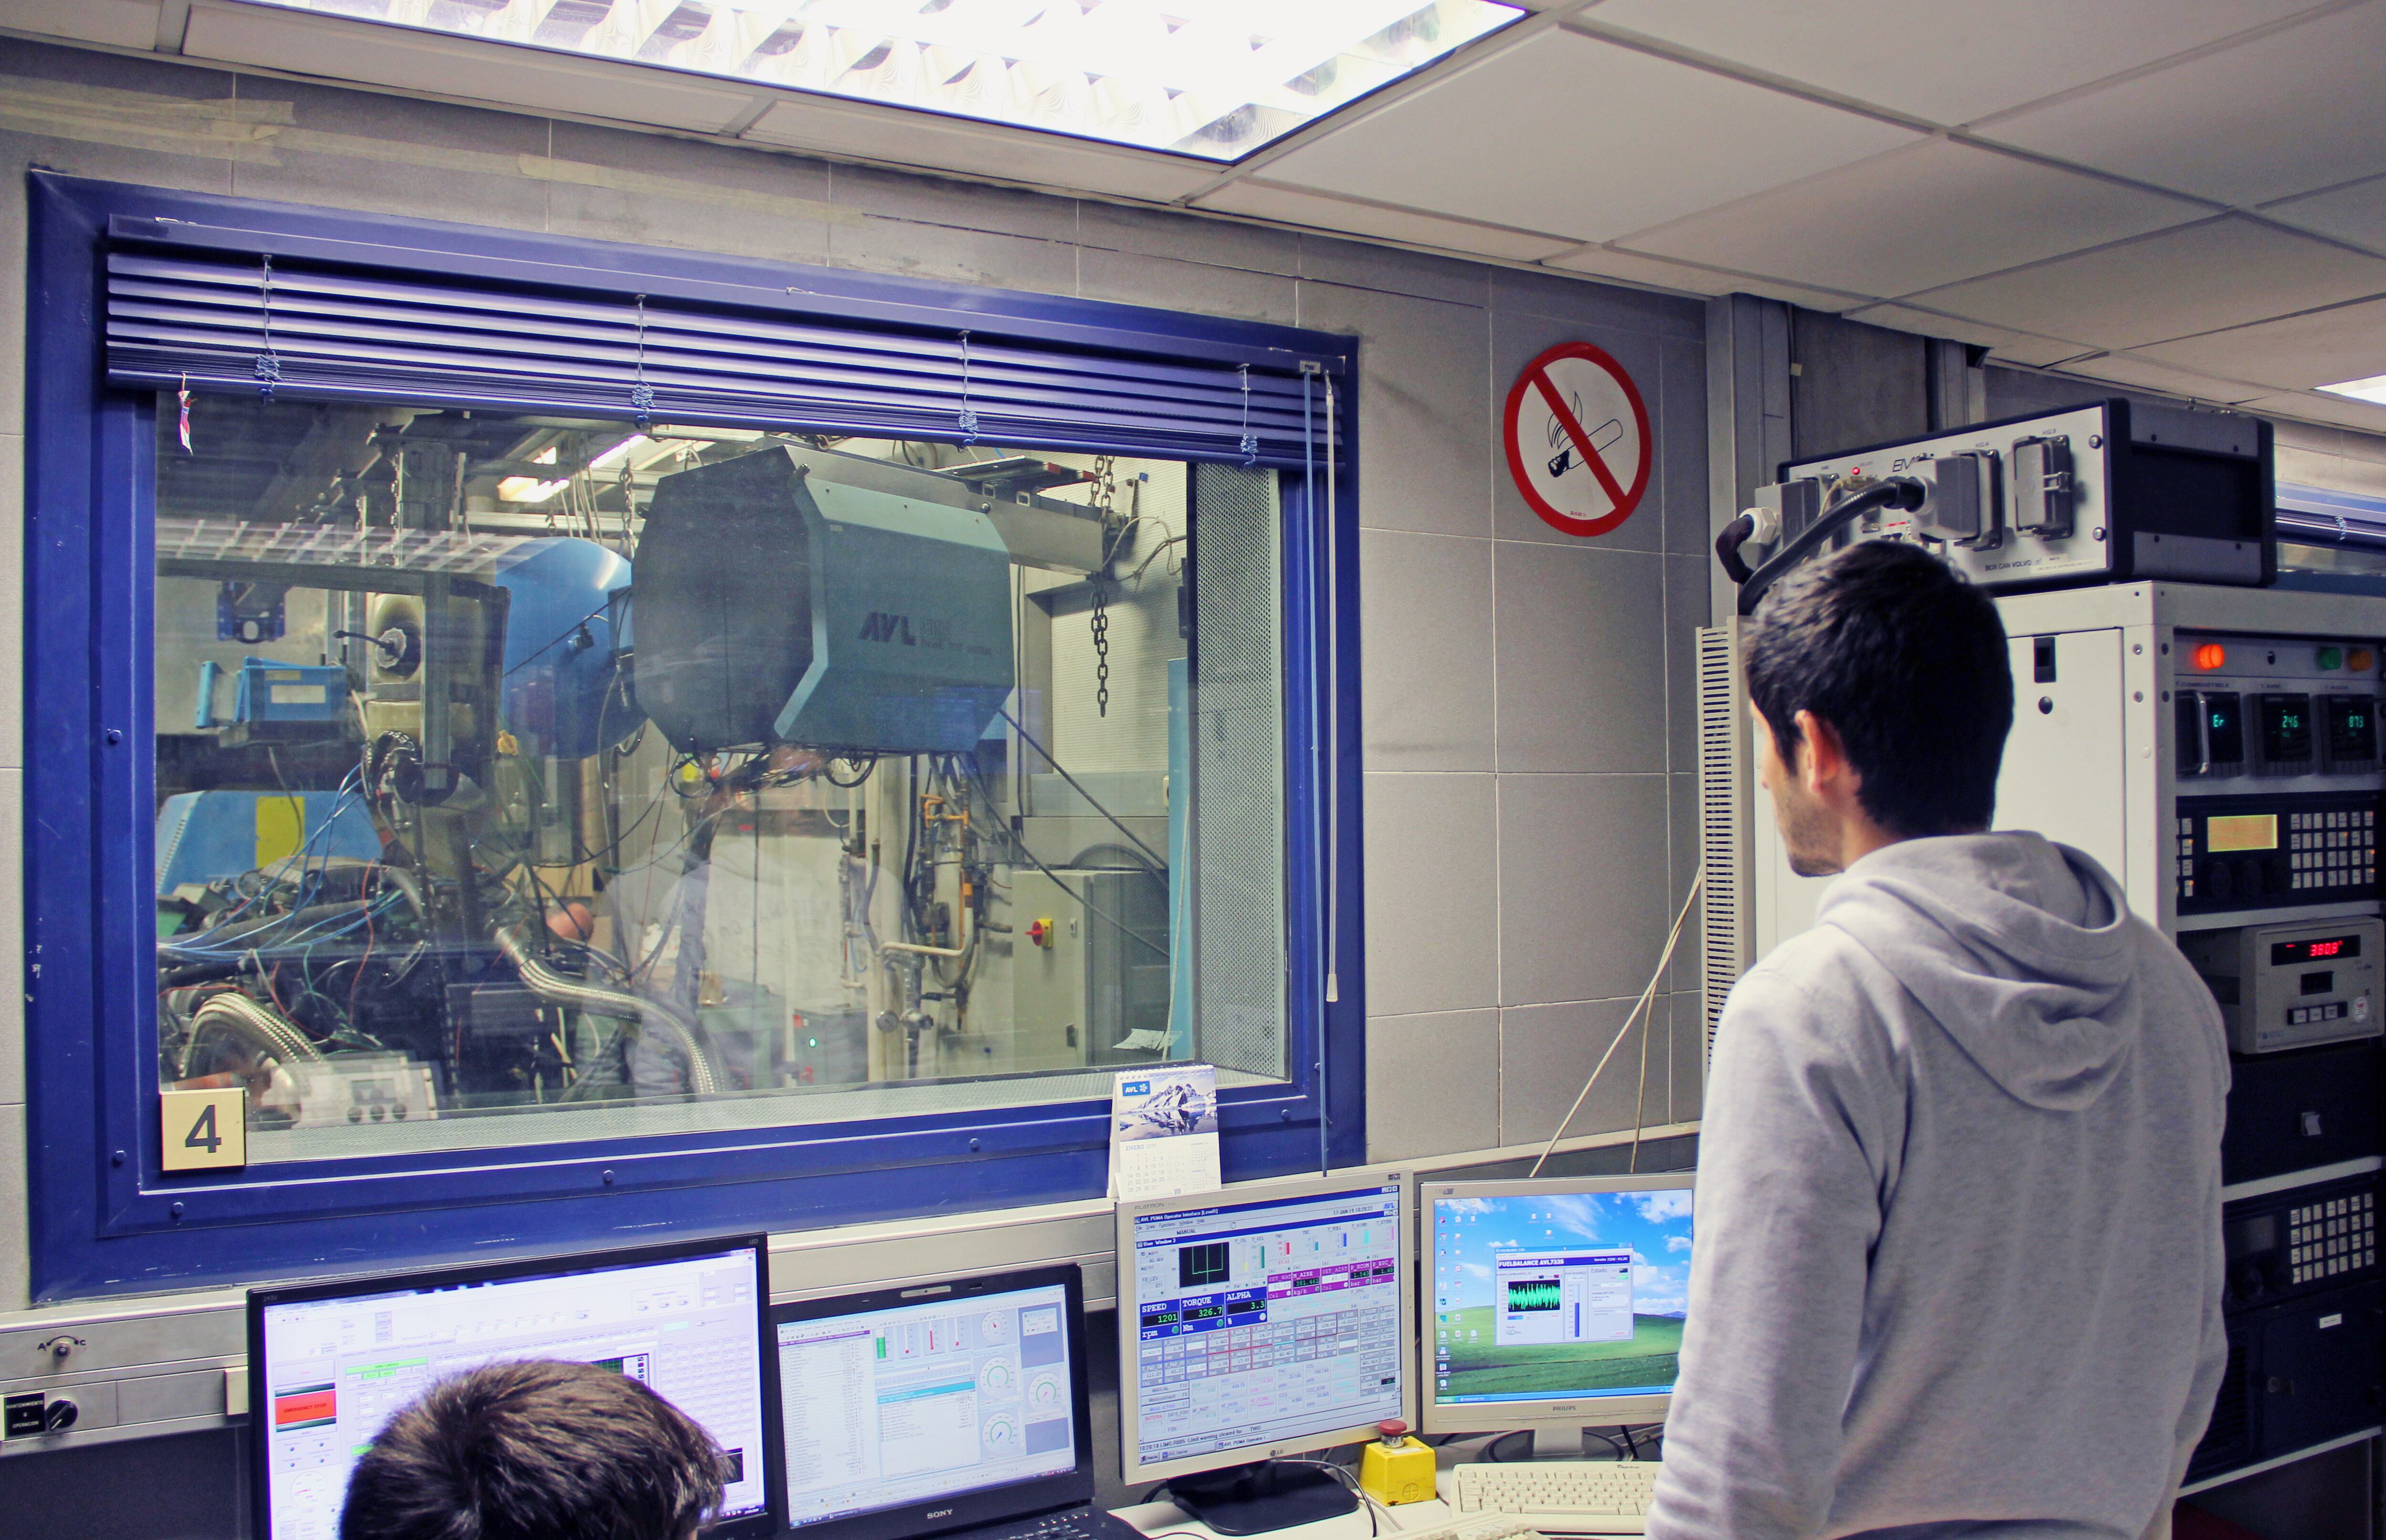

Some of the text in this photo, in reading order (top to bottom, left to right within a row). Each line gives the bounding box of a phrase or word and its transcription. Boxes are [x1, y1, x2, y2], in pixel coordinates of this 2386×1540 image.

[2012, 560, 2031, 568] VOLVO
[858, 612, 916, 646] AVL
[1125, 1086, 1139, 1094] AVL
[185, 1104, 222, 1154] 4
[1226, 1291, 1252, 1301] ALPHA
[1183, 1297, 1212, 1308] TORQUE
[1251, 1301, 1265, 1310] 3.3
[1141, 1303, 1167, 1313] SPEED
[1198, 1306, 1223, 1317] 326.7
[1158, 1313, 1178, 1323] 1201
[1183, 1324, 1194, 1332] Nm
[1141, 1329, 1159, 1340] rpm
[37, 1342, 46, 1352] A
[927, 1509, 953, 1519] SONY
